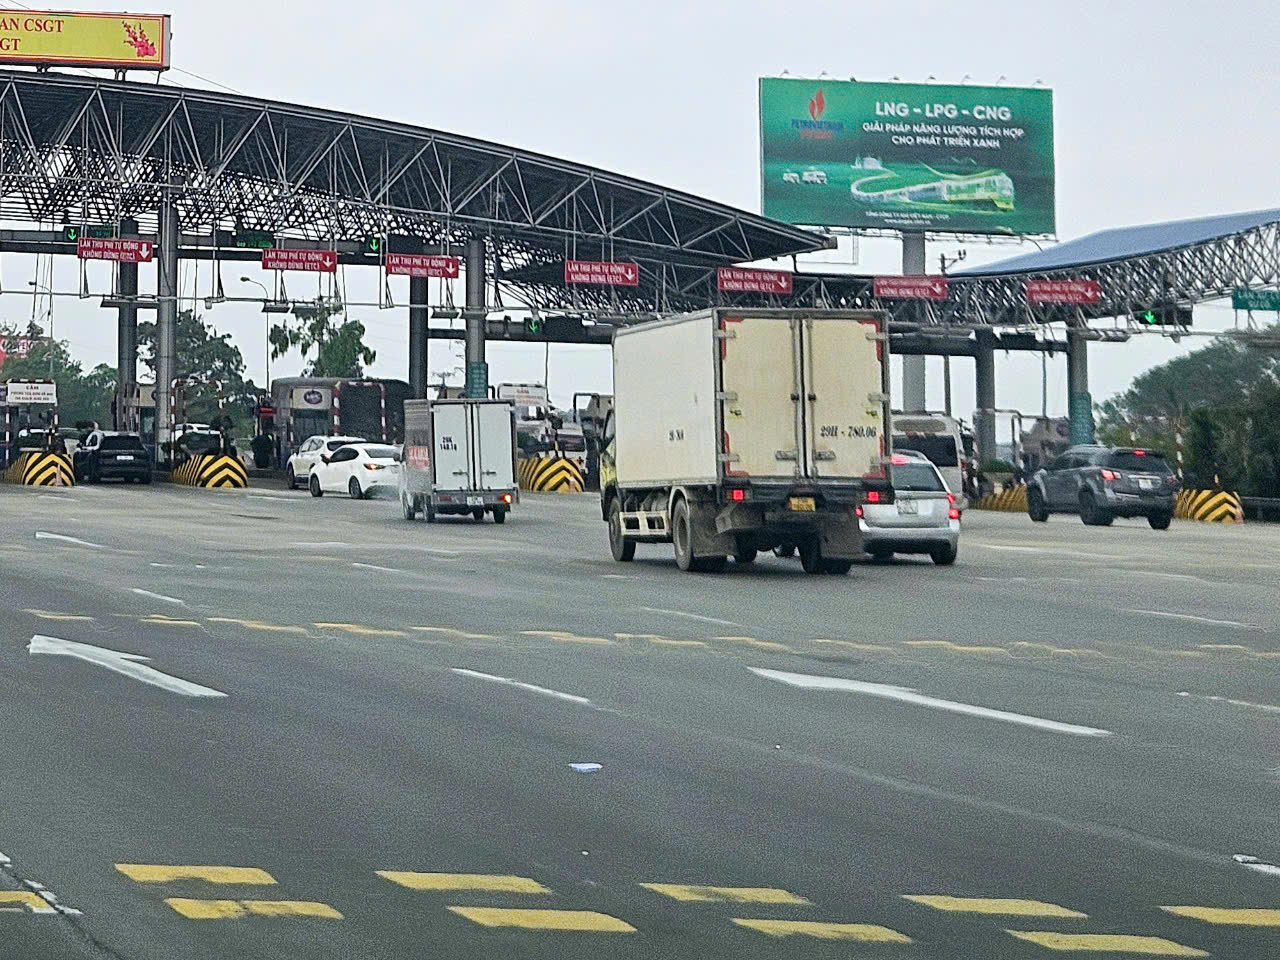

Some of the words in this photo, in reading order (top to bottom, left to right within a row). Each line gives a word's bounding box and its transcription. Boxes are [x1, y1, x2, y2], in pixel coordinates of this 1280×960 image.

[24, 18, 64, 33] CSGT
[875, 101, 909, 117] LNG
[925, 103, 958, 119] LPG
[973, 105, 1011, 121] CNG
[885, 122, 911, 133] PHÁP
[943, 124, 977, 137] LƯỢNG
[979, 124, 1001, 137] TÍCH
[892, 135, 914, 145] CHO
[916, 134, 942, 146] PHÁT
[972, 138, 1000, 149] XANH
